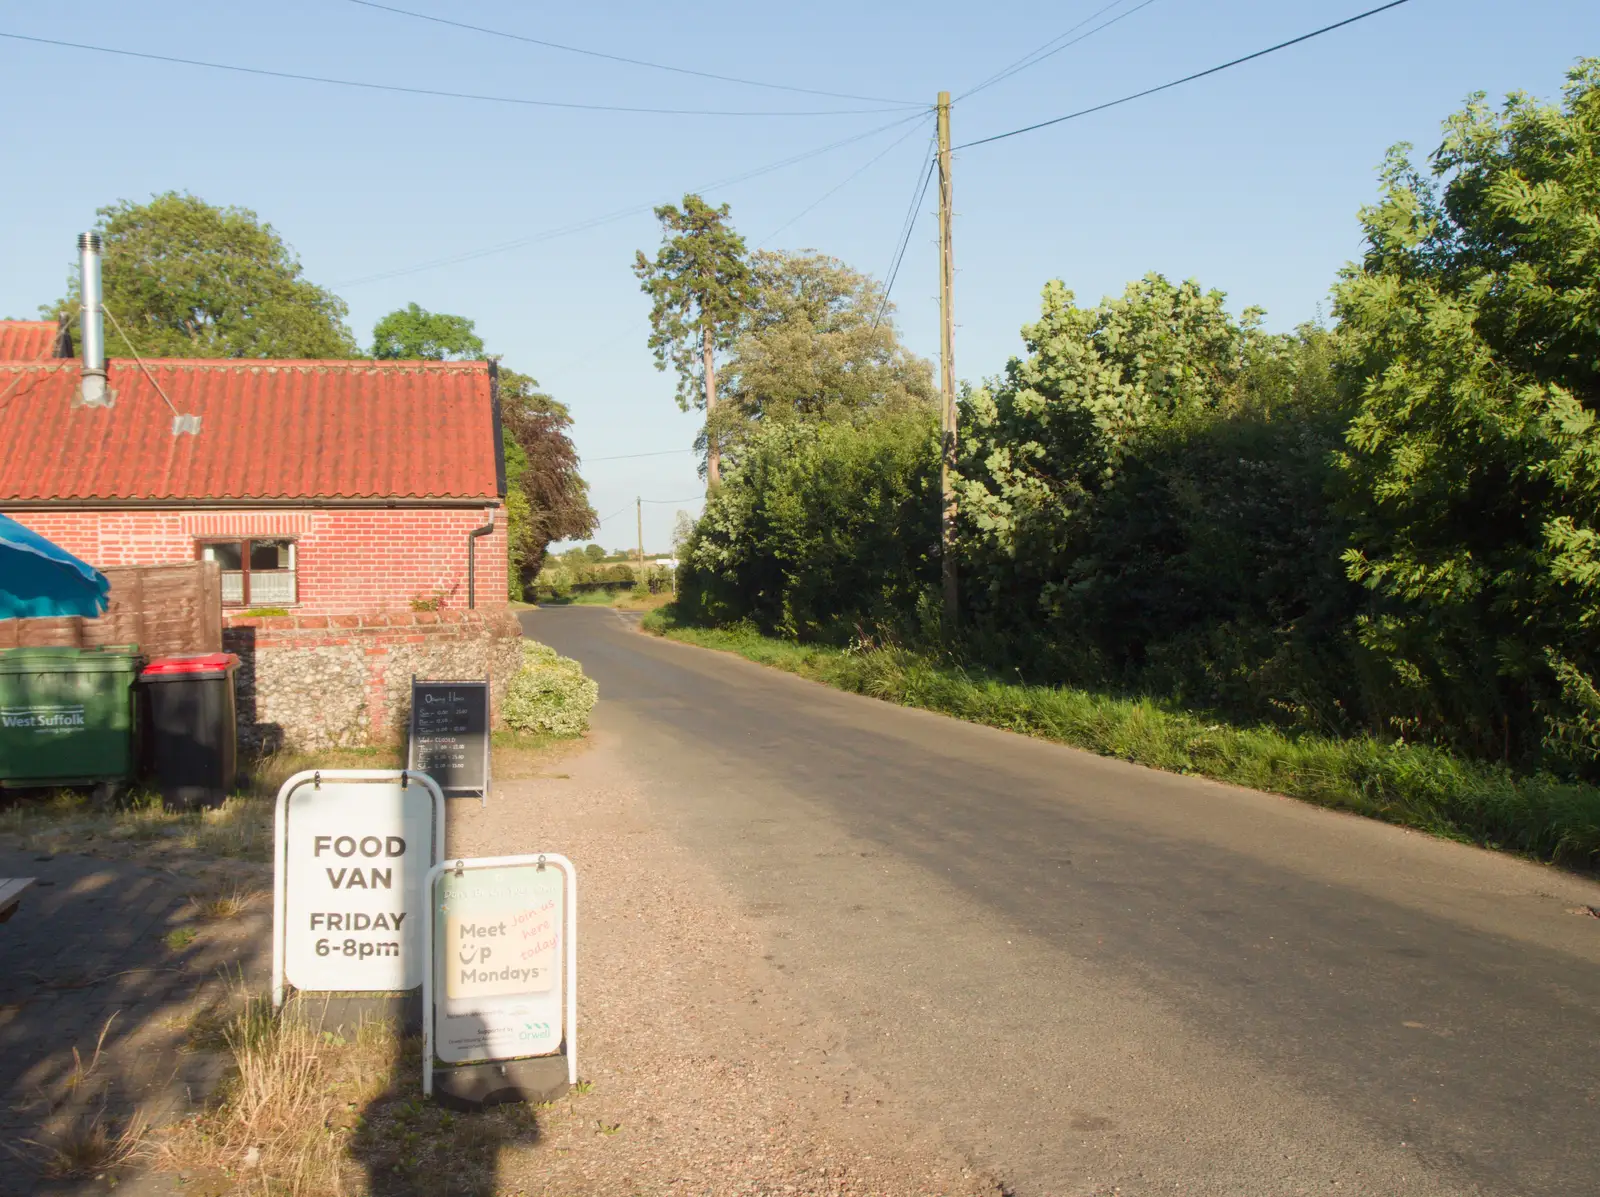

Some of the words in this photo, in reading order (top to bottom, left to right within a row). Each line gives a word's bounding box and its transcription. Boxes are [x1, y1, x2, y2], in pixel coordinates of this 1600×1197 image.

[1, 716, 36, 727] West
[38, 714, 84, 726] Suffolk
[314, 835, 406, 858] FOOD
[326, 867, 392, 890] VAN
[310, 912, 407, 931] FRIDAY
[511, 908, 537, 927] Join
[540, 898, 555, 913] us
[459, 921, 507, 940] Meet
[521, 920, 550, 940] here
[315, 938, 400, 960] 6-8pm
[520, 932, 561, 961] today!
[460, 964, 540, 985] Mondays
[518, 1028, 551, 1041] Orwell
